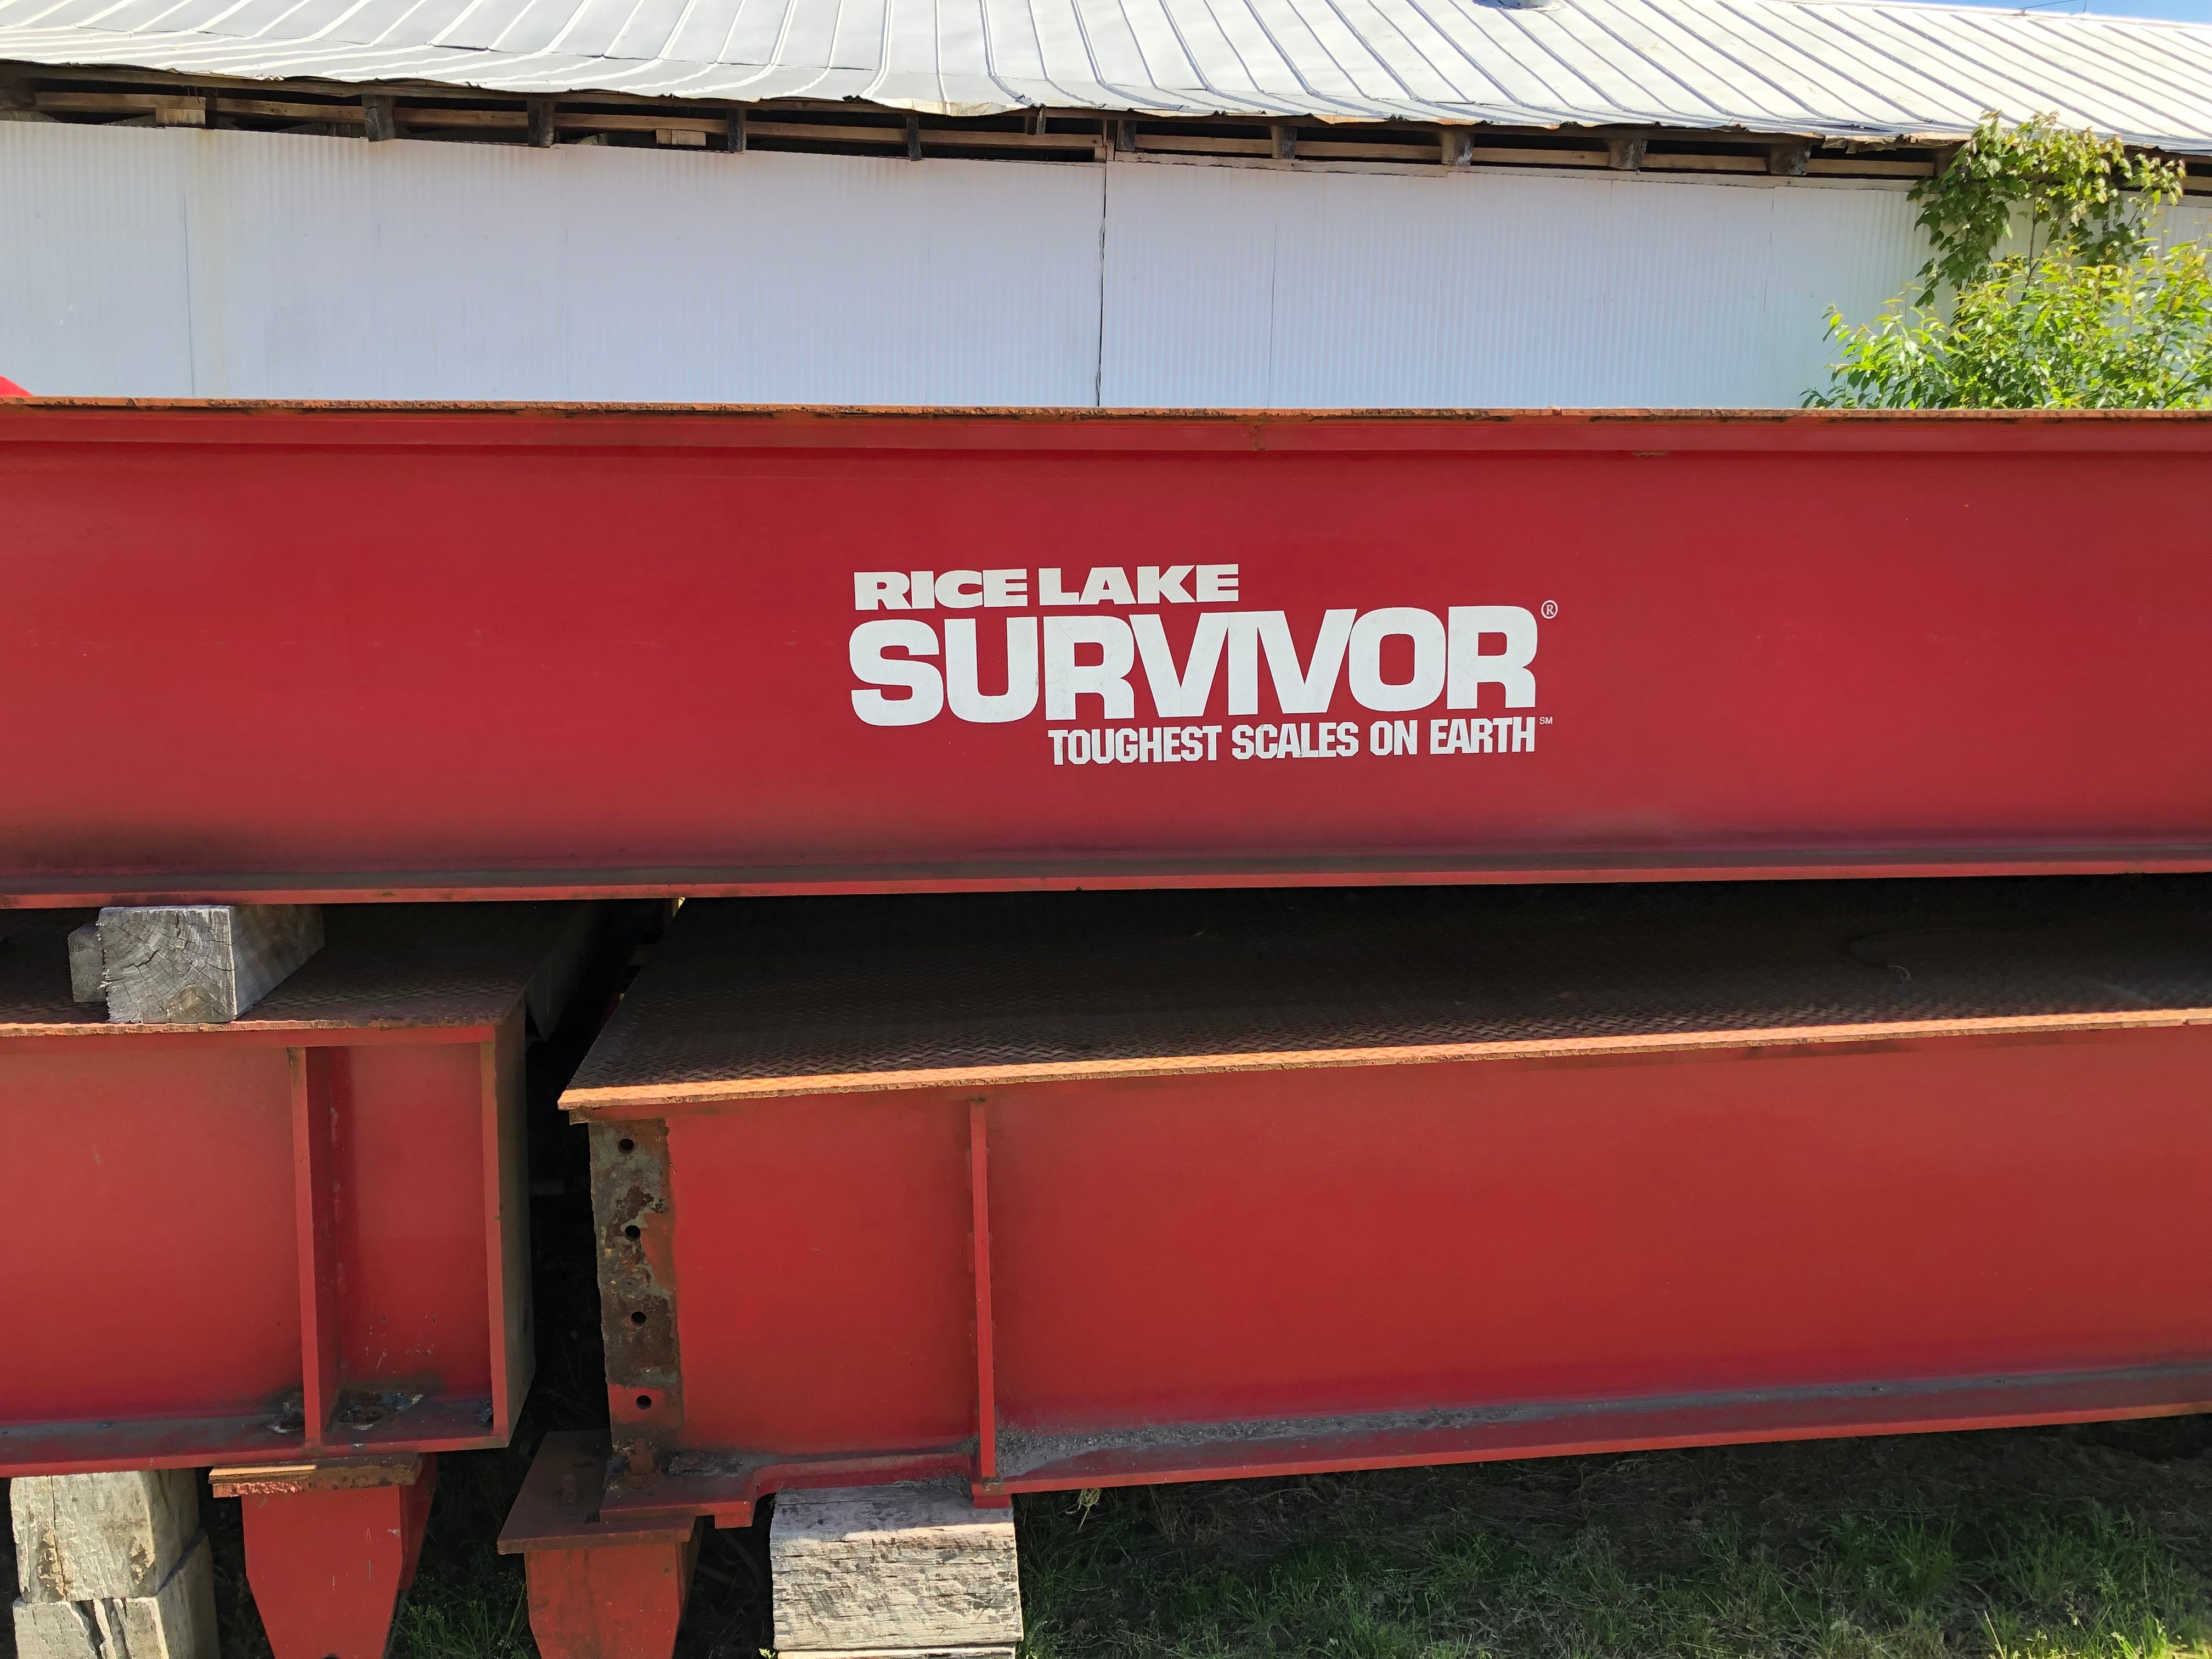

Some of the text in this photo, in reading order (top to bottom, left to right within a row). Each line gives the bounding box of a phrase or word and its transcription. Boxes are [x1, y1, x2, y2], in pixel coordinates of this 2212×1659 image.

[854, 563, 1239, 611] RICE LAKE
[849, 605, 1538, 726] SURVIVOR
[1047, 716, 1553, 765] TOUGHEST SCALES ON EARTH SM
